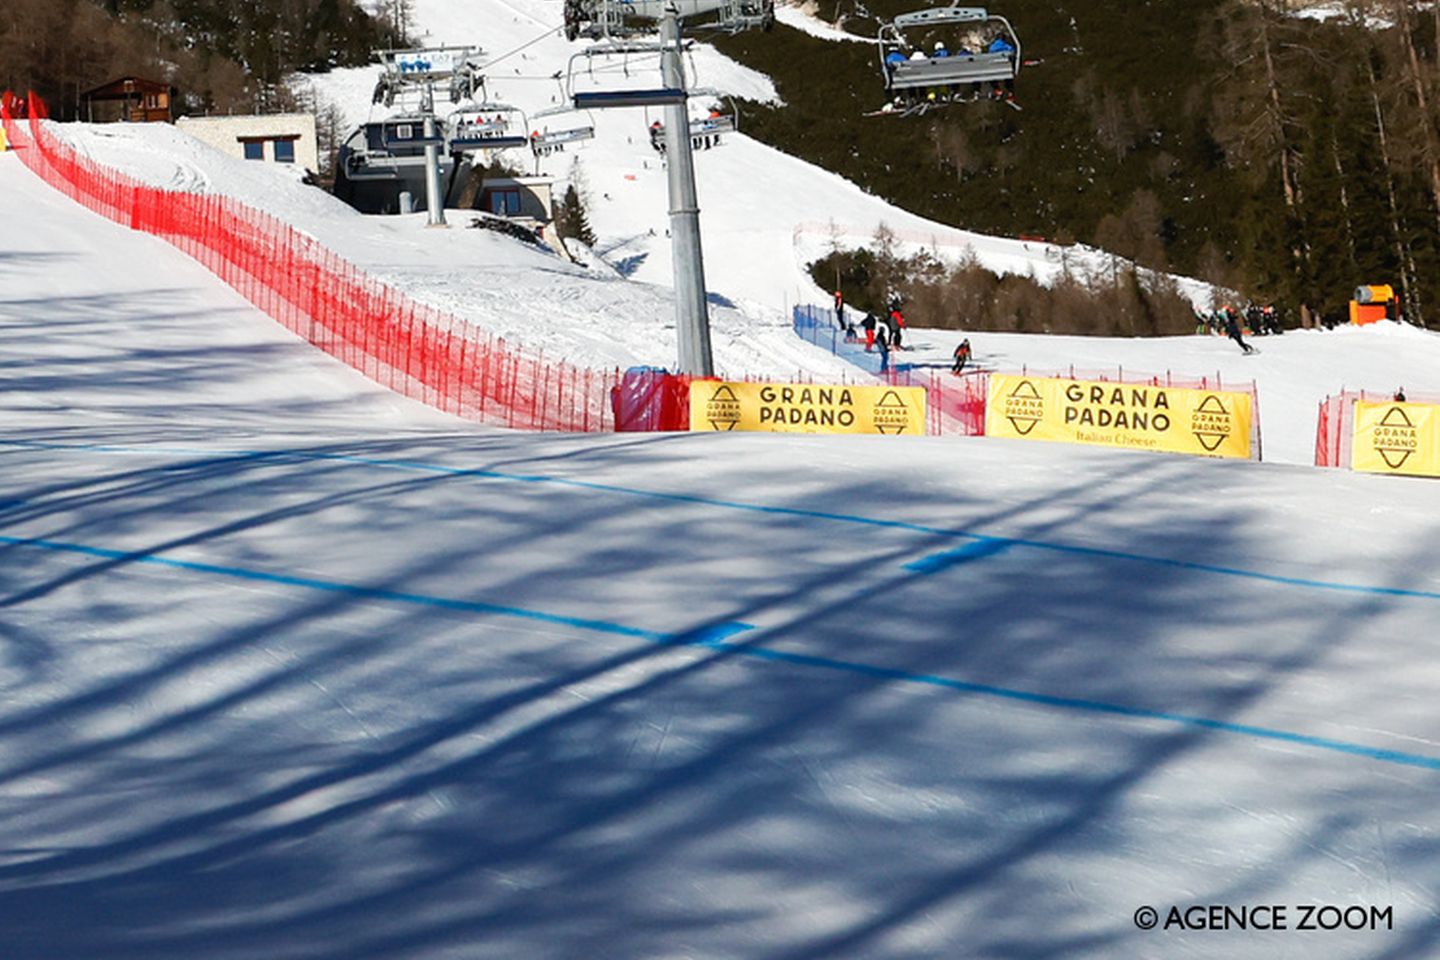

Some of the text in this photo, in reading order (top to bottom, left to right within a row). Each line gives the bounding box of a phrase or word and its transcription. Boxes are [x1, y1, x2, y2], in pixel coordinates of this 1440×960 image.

[759, 386, 853, 406] GRANA
[1066, 384, 1169, 409] GRANA
[1006, 399, 1044, 408] GRANA
[759, 407, 855, 427] PADANO
[1005, 408, 1044, 417] PADANO
[1065, 406, 1170, 432] PADANO
[1192, 414, 1230, 423] GRANA
[1191, 423, 1231, 432] PADANO
[1374, 428, 1416, 437] GRANA
[1076, 431, 1157, 447] Italian Cheese
[1373, 437, 1418, 448] PADANO
